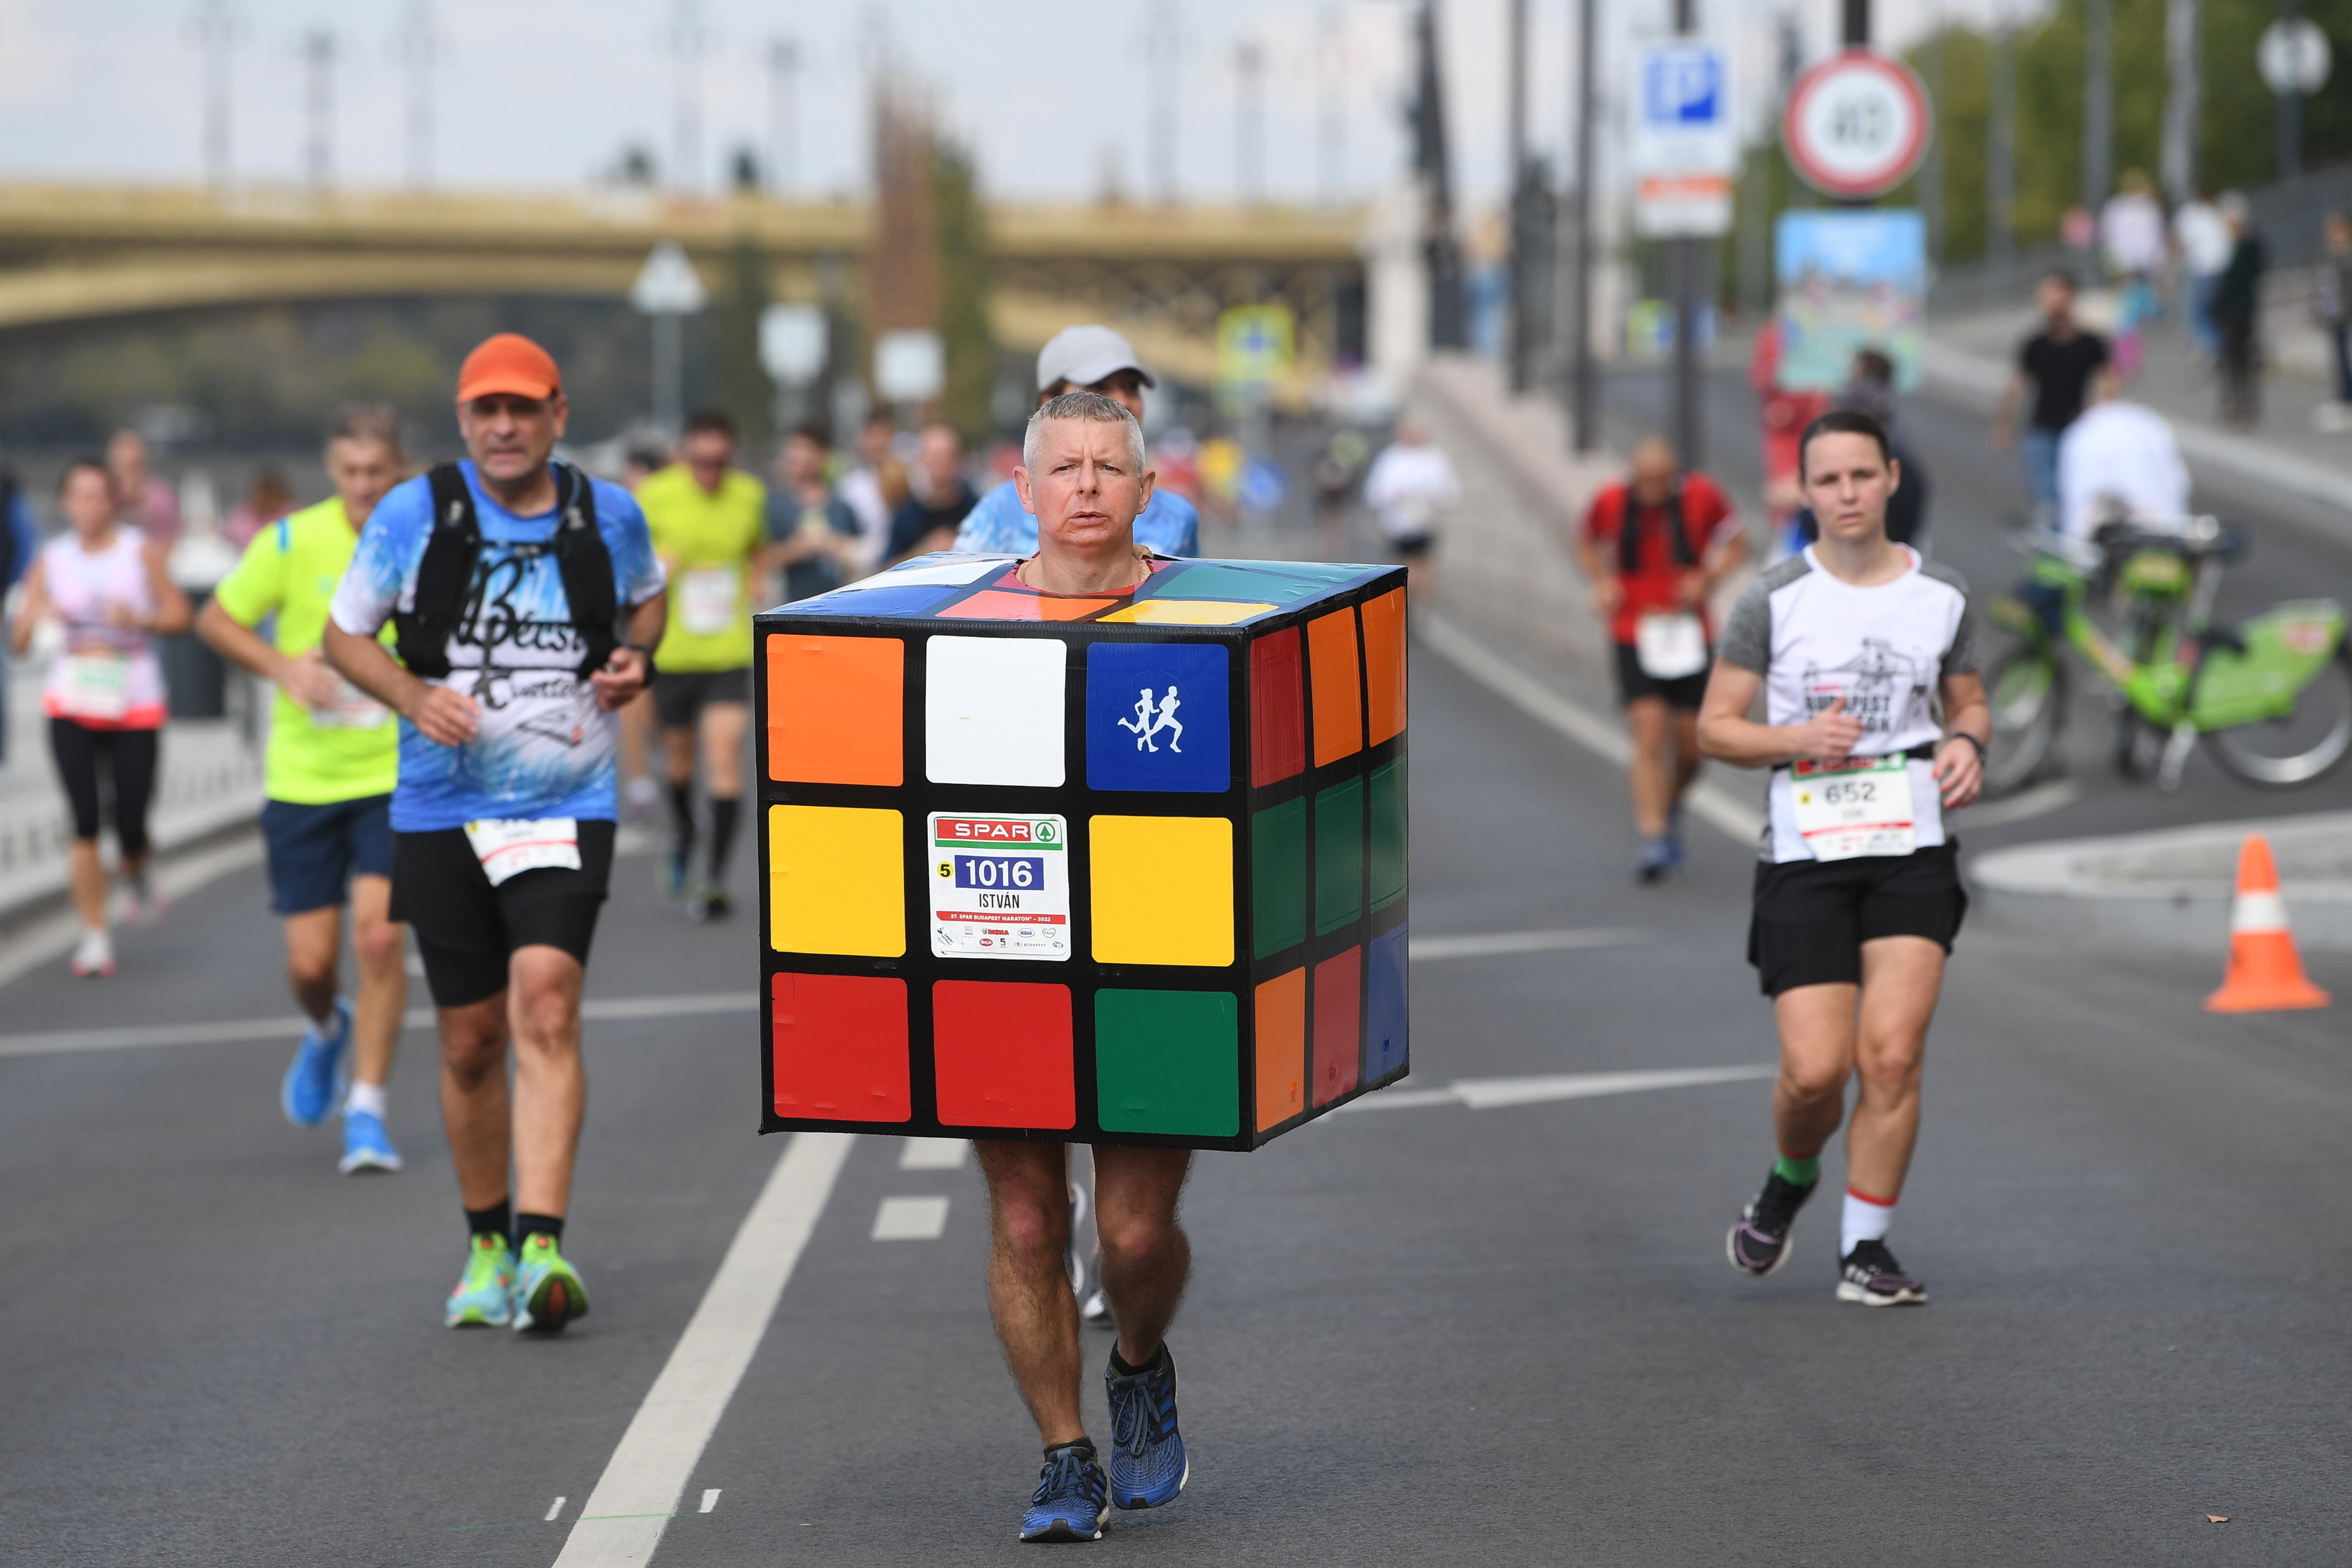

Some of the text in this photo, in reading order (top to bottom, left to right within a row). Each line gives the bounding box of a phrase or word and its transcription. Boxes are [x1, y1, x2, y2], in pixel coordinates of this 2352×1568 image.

[1806, 696, 1890, 713] BUDPEST
[1825, 780, 1876, 805] 652
[954, 822, 1029, 838] SPAR
[940, 864, 950, 878] 5
[965, 859, 1032, 887] 1016
[979, 892, 1020, 908] ISTVÁN
